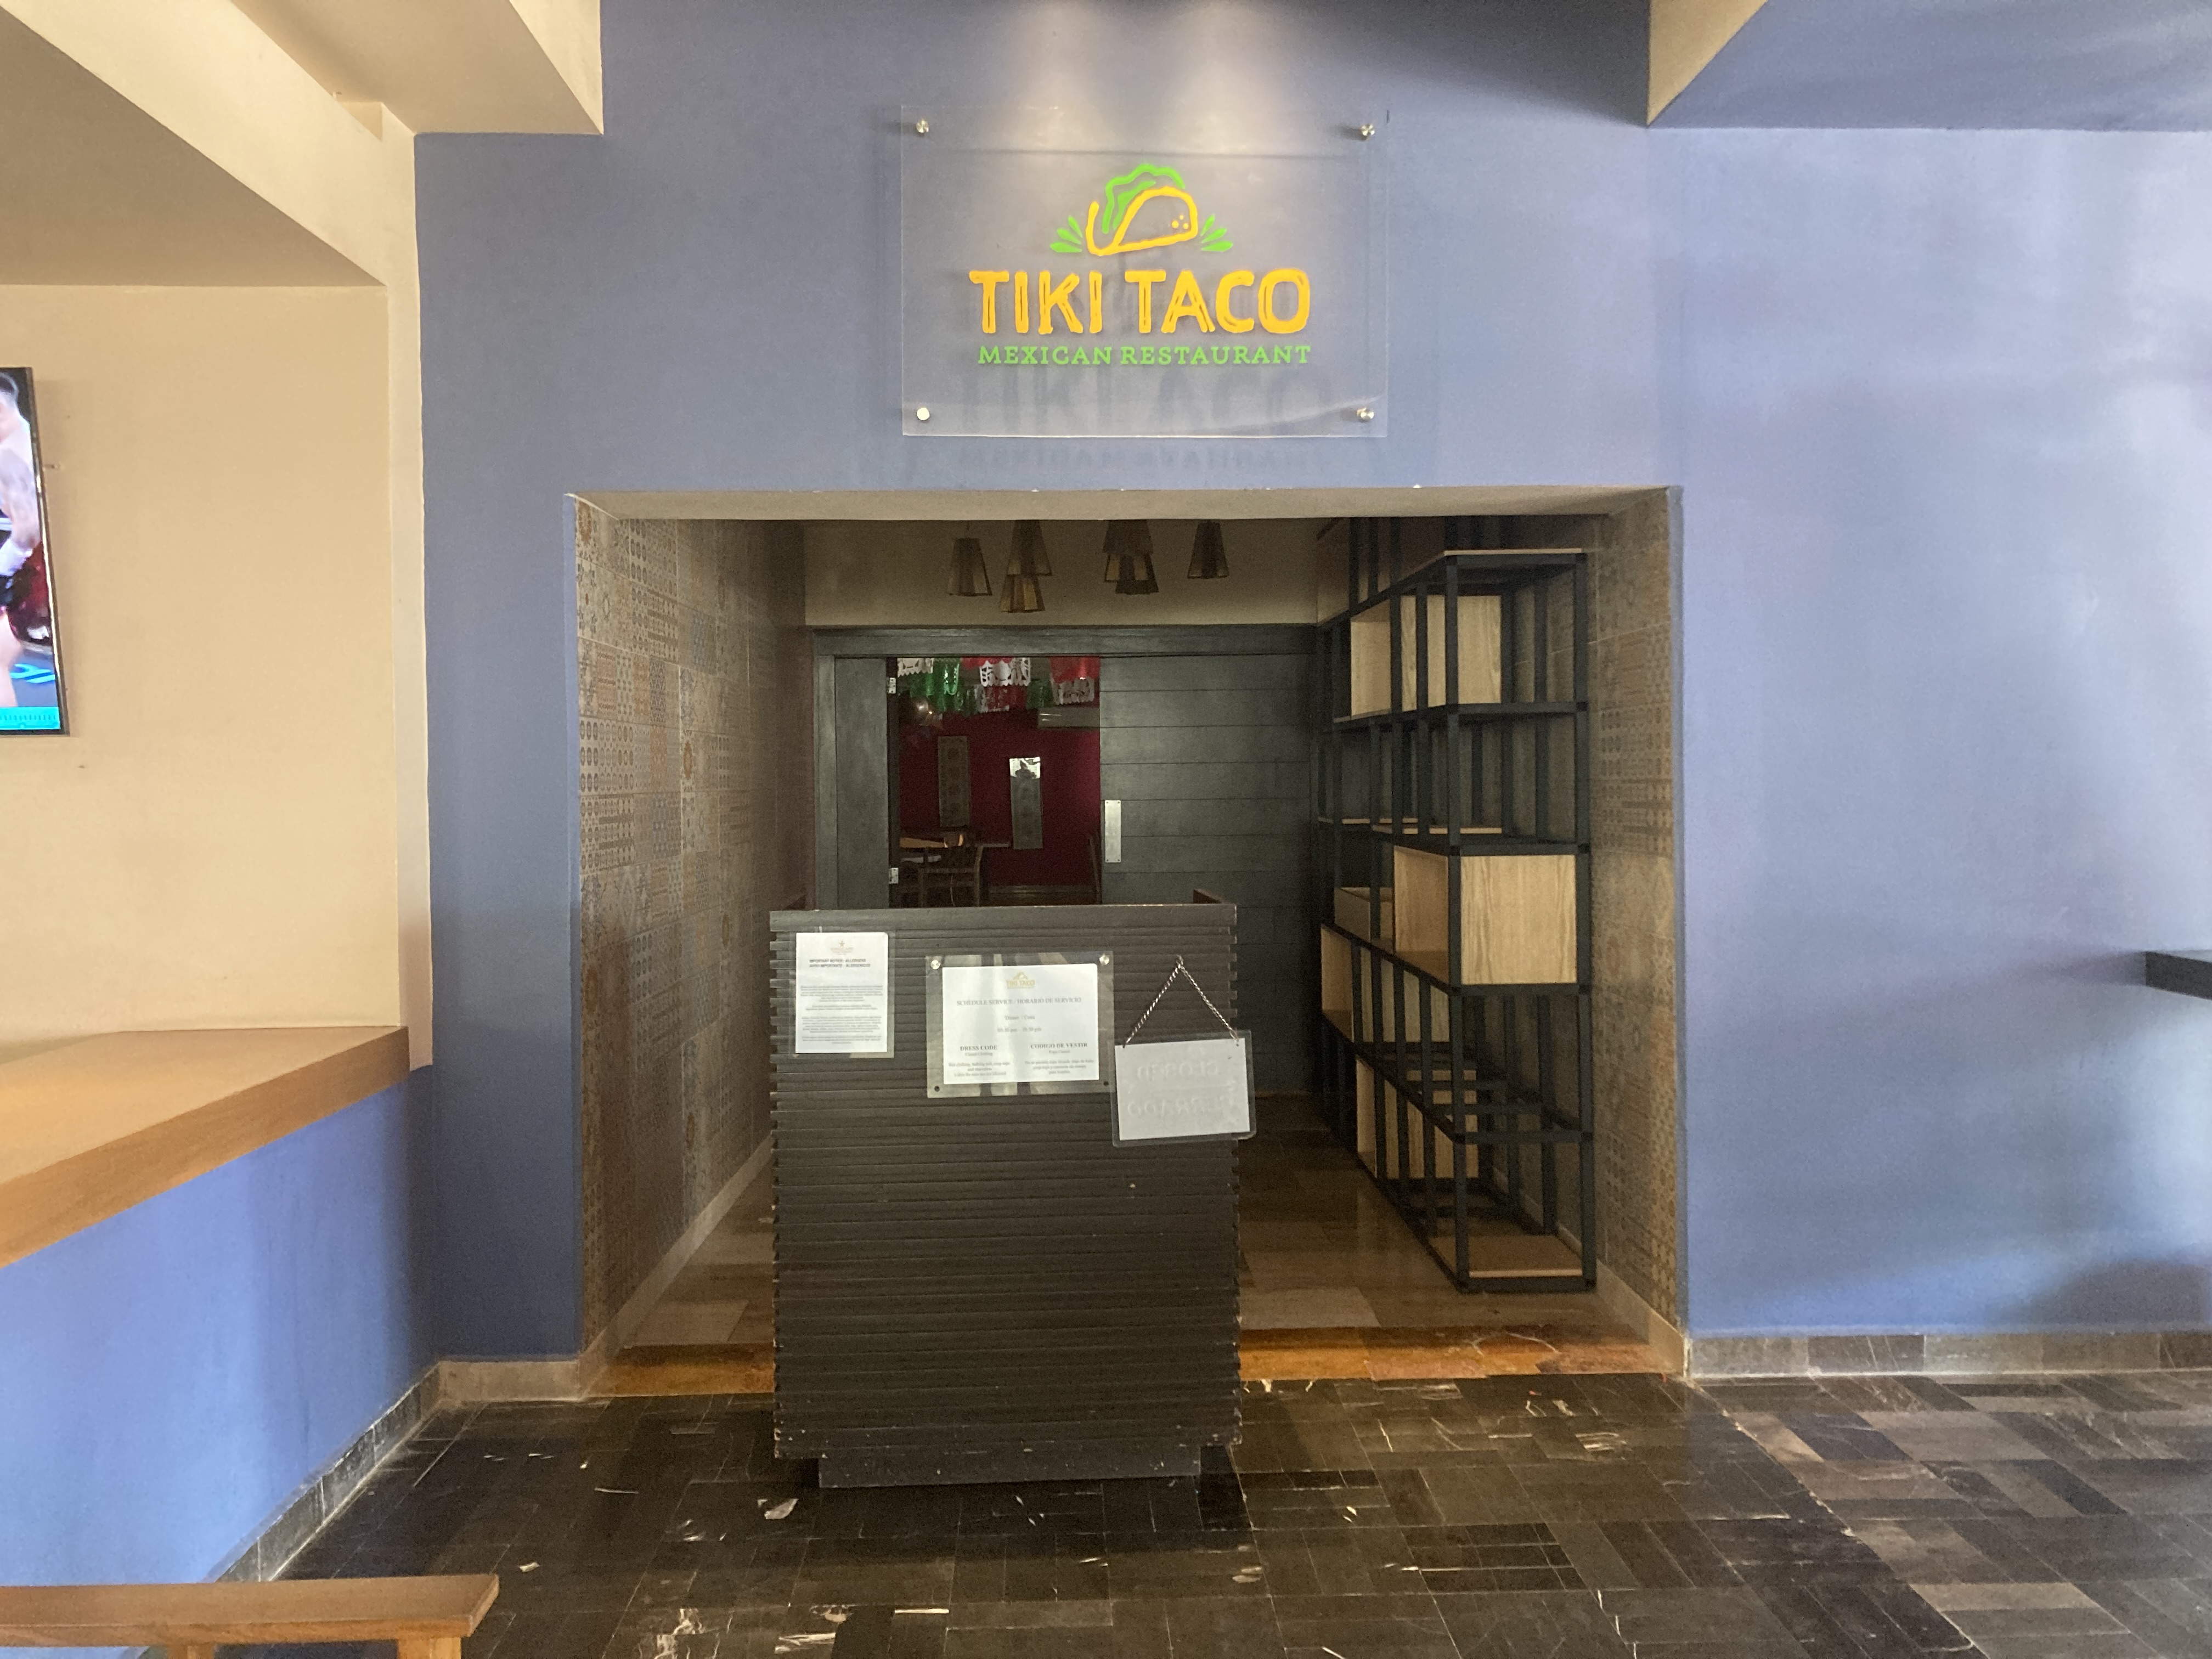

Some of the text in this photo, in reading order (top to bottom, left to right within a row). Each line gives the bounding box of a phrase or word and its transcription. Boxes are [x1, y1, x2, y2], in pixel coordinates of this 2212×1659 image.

[969, 268, 1310, 334] TIKI TACO
[978, 346, 1311, 365] MEXICAN RESTAURANT
